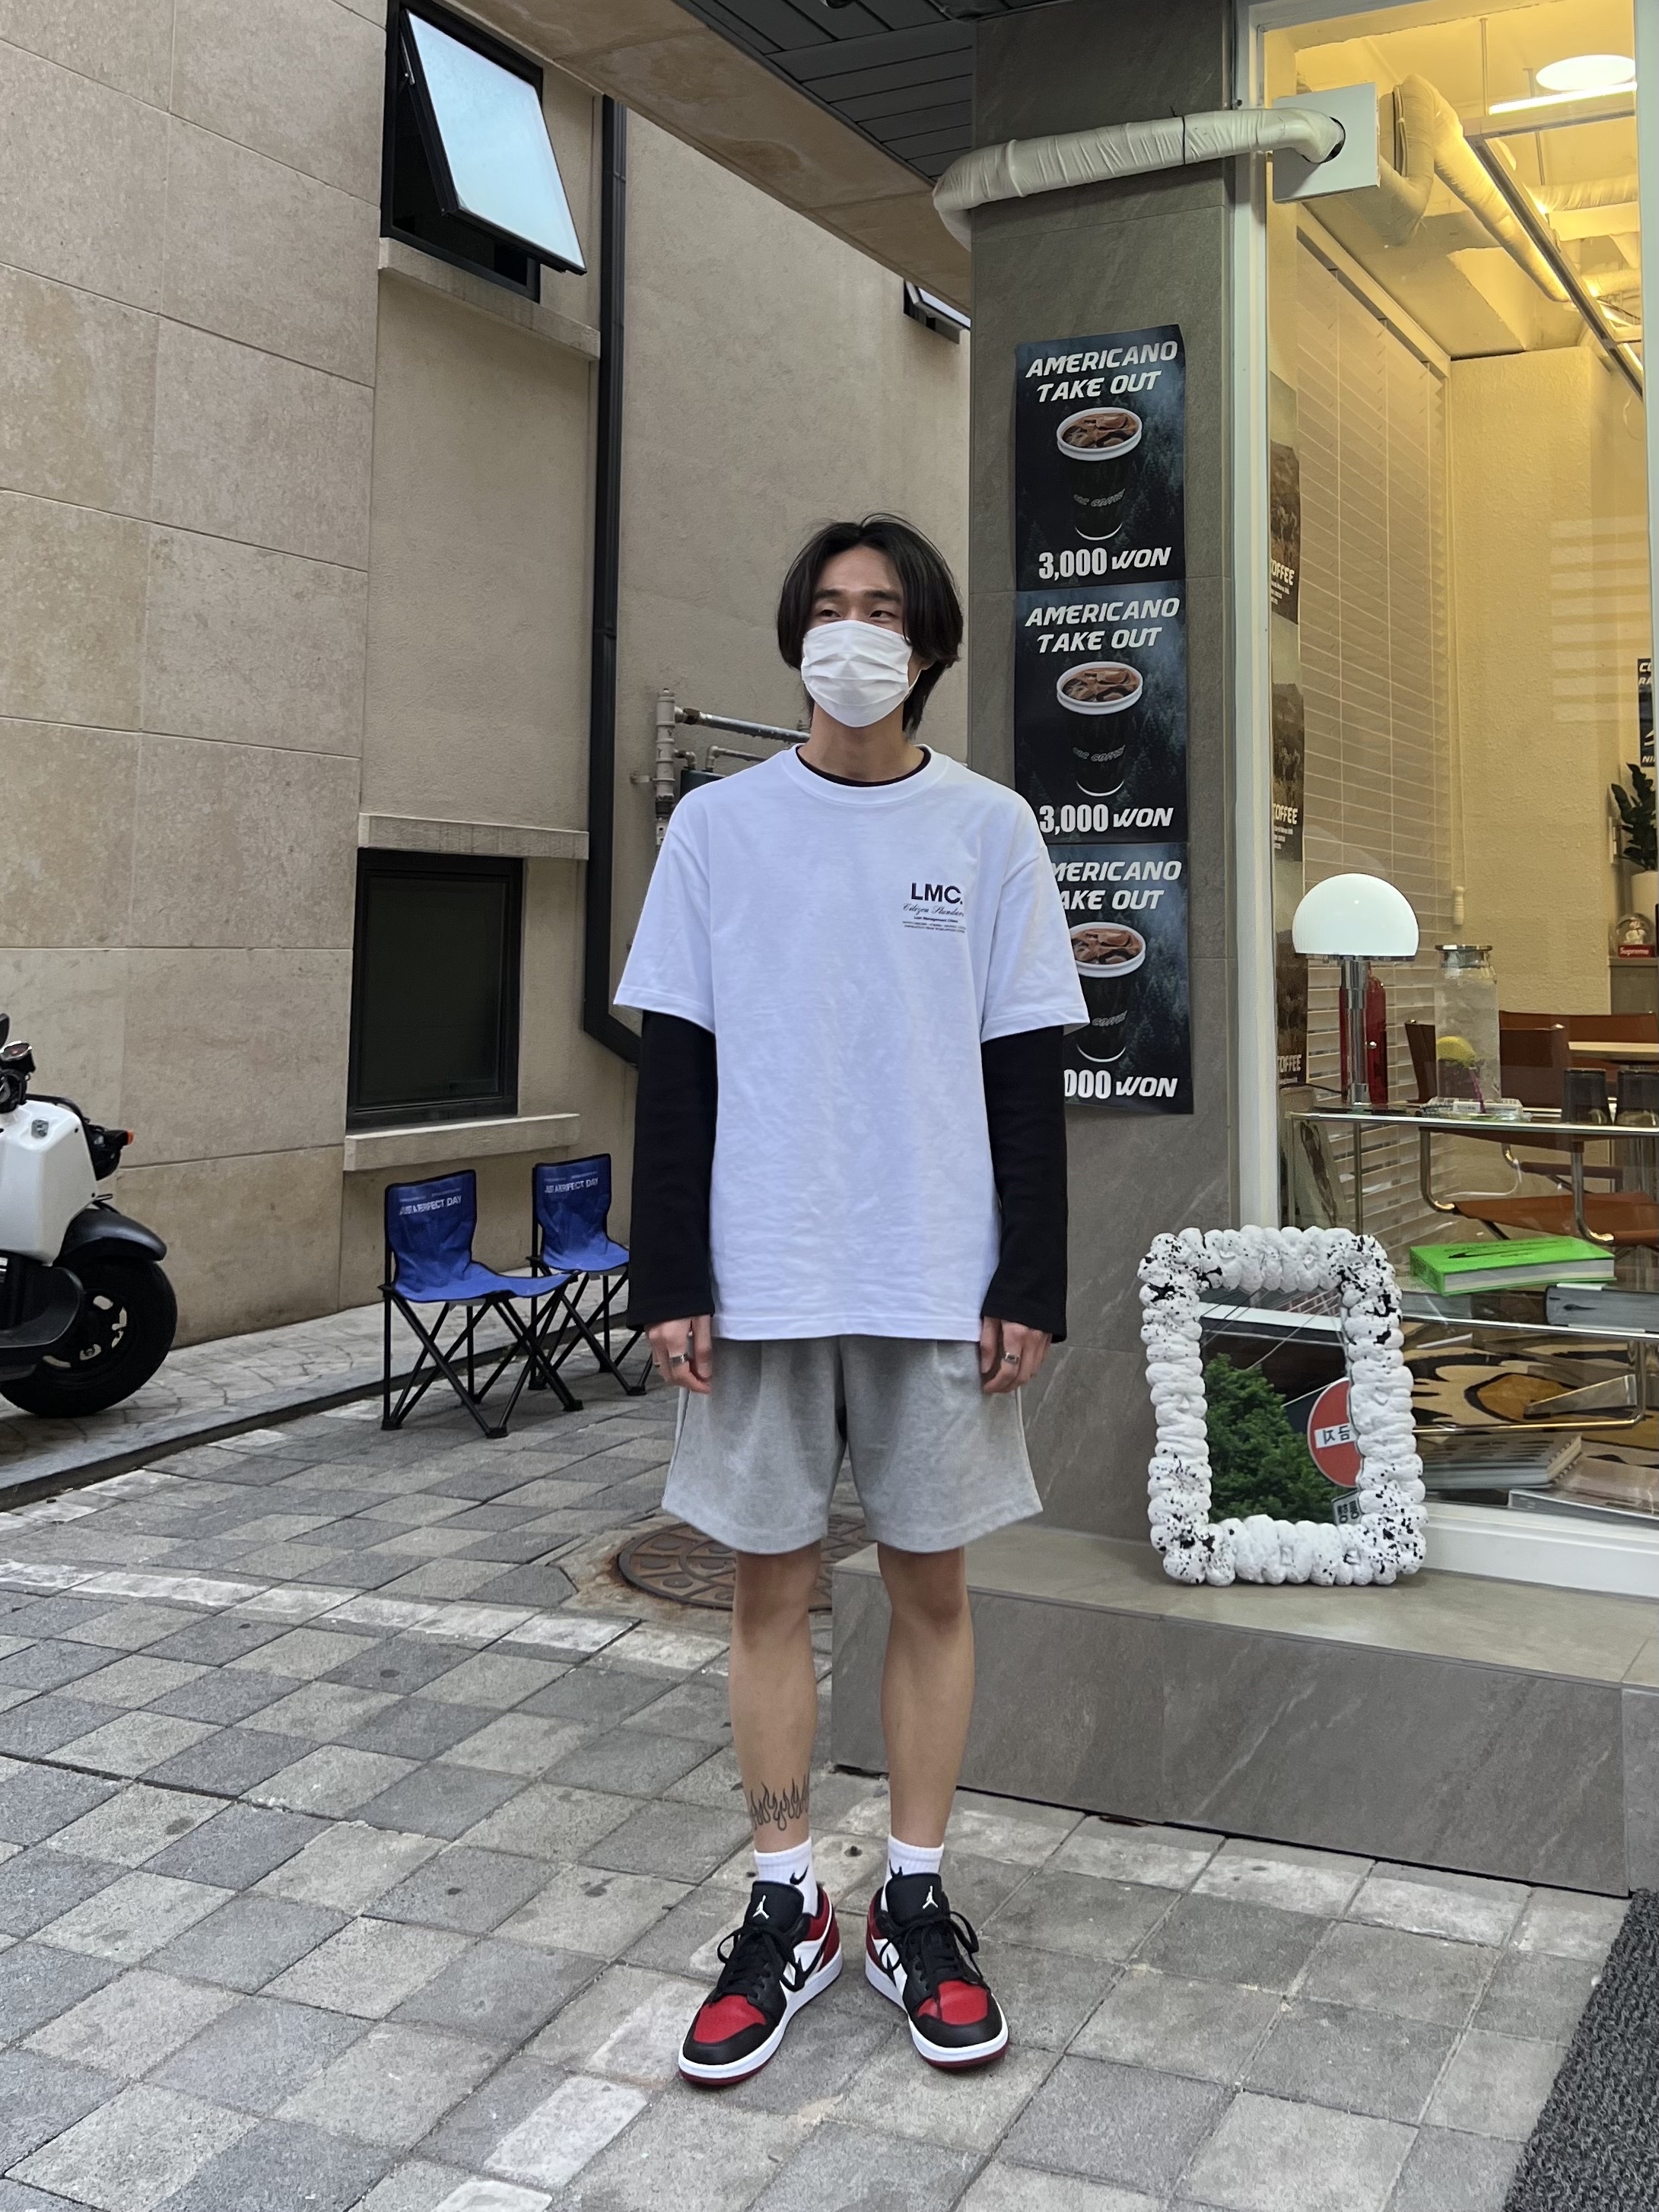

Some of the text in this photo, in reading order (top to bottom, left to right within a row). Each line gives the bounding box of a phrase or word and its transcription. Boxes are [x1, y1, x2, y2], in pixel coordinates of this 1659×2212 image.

[1025, 341, 1178, 378] AMERICANO
[1037, 370, 1162, 402] TAKE OUT
[1038, 547, 1172, 581] 3,000 WON
[1271, 560, 1295, 586] OFFEE
[1025, 597, 1181, 627] AMERICANO
[1037, 627, 1162, 653] TAKE OUT
[1039, 804, 1174, 836] 3,000 WON
[1051, 860, 1182, 882] MERICANO
[911, 882, 963, 904] LMC.
[1060, 889, 1165, 911] AKE OUT
[1619, 946, 1650, 957] Supreme
[1064, 1069, 1178, 1099] 000 WON
[447, 1195, 462, 1207] DAY
